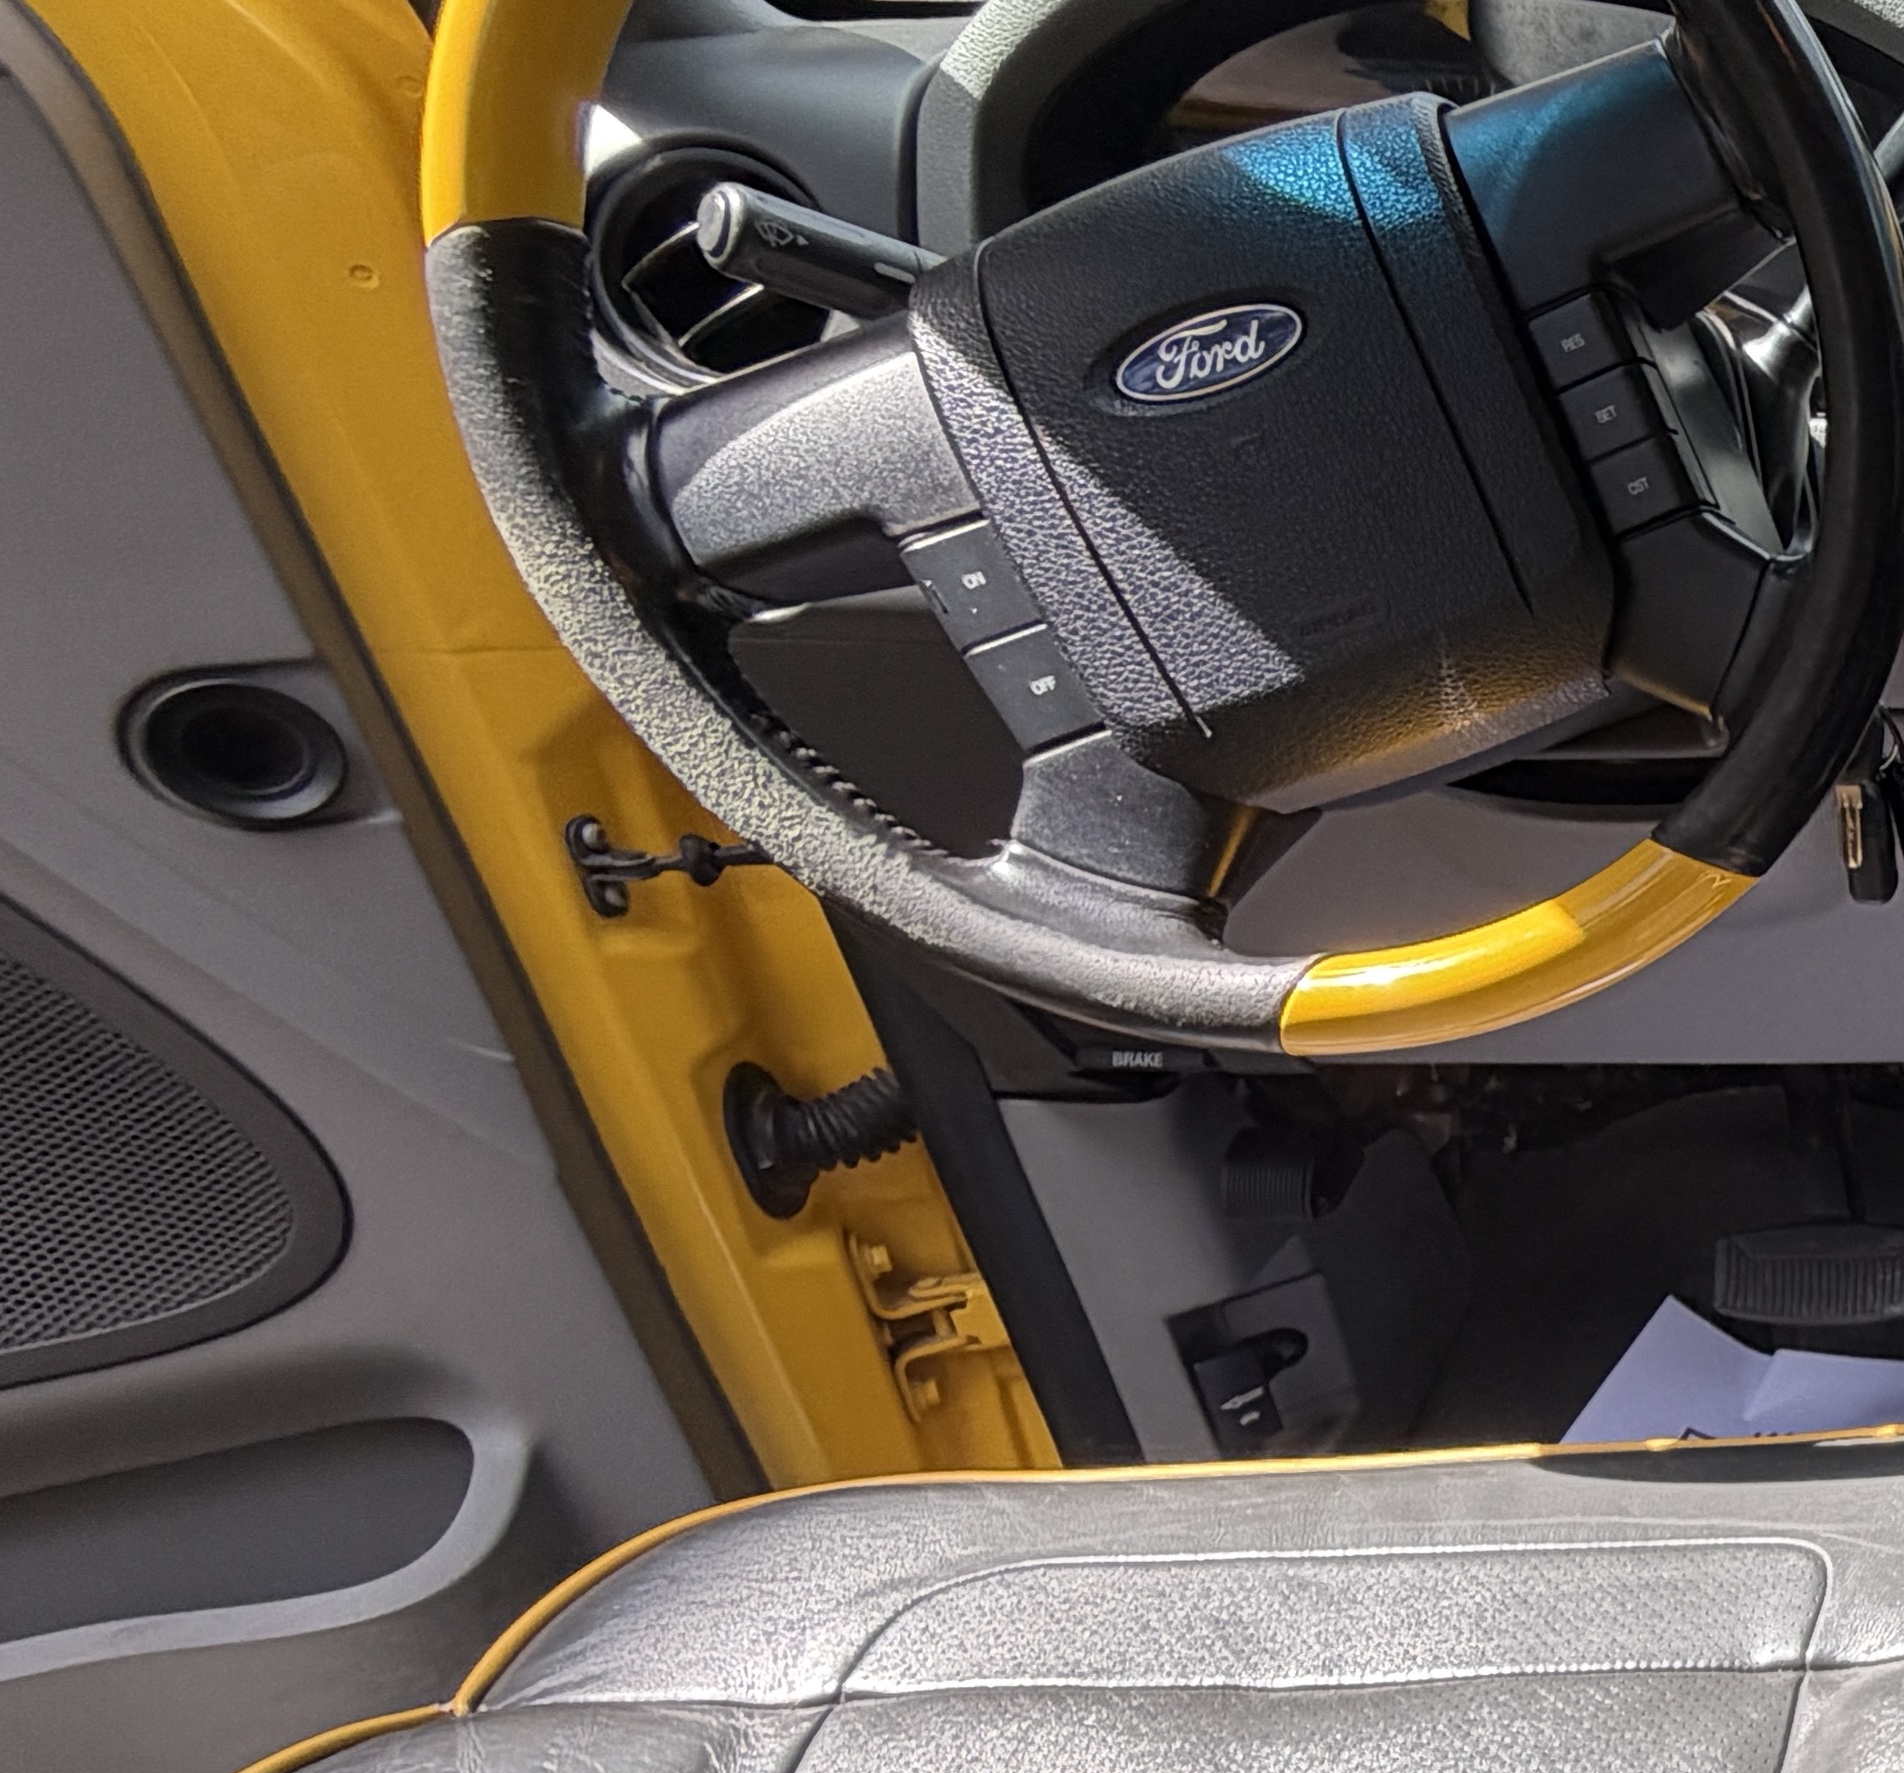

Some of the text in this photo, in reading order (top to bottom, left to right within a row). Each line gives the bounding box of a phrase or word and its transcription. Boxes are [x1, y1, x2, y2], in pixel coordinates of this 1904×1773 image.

[1156, 319, 1266, 389] Ford
[1595, 404, 1618, 424] SET
[961, 571, 987, 590] ON
[1029, 675, 1056, 696] OFF
[1112, 1051, 1163, 1068] BRAKE
